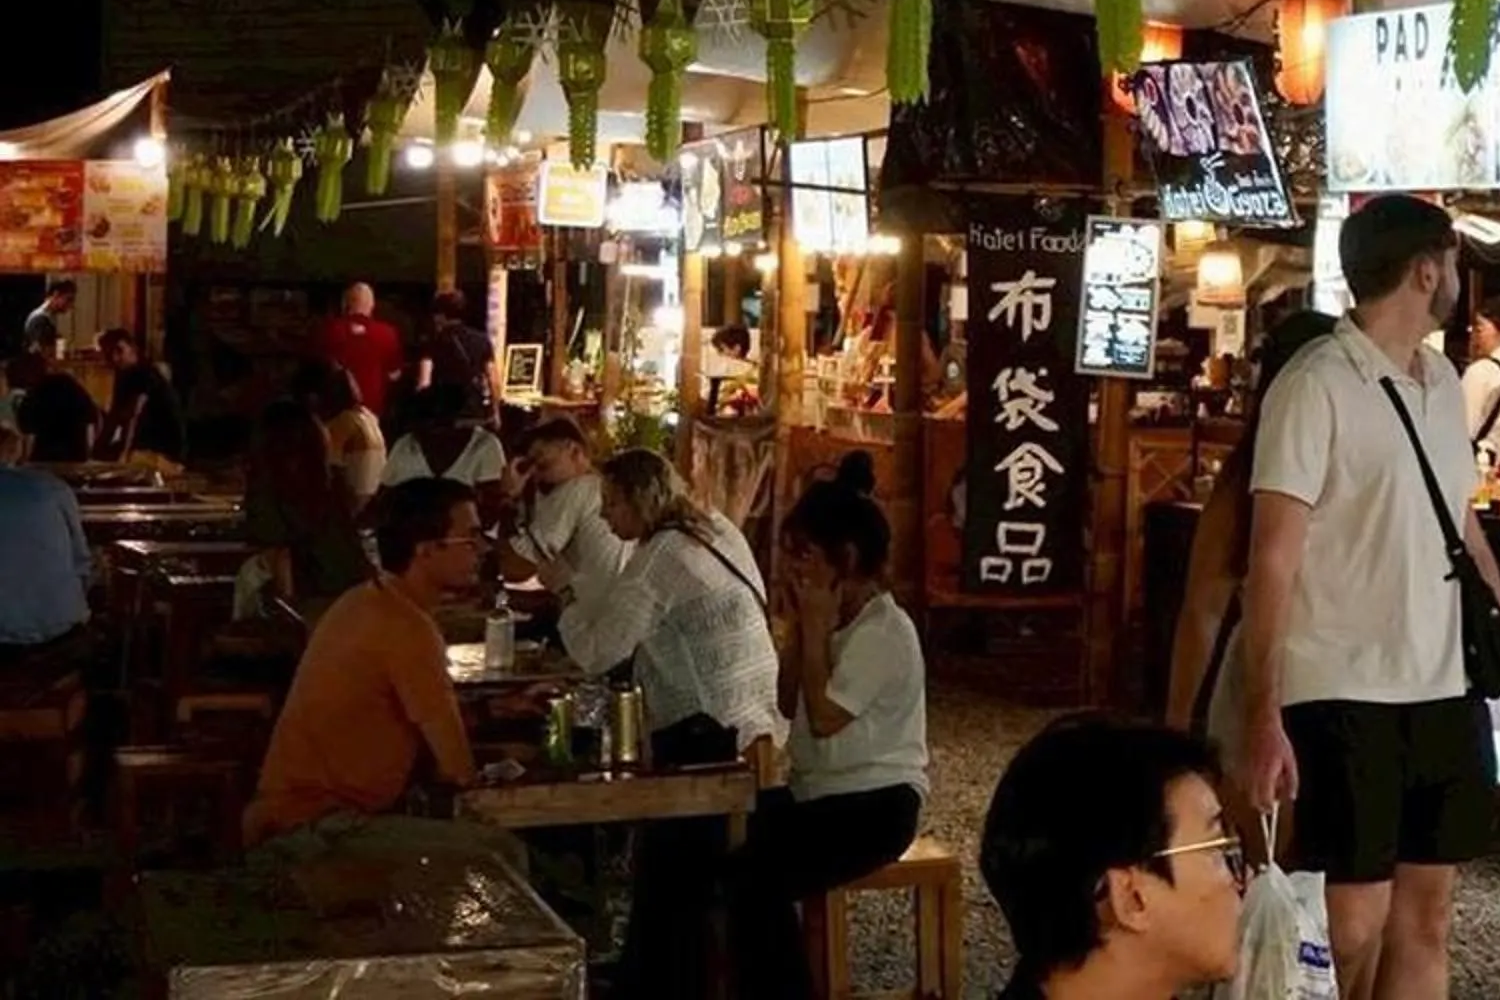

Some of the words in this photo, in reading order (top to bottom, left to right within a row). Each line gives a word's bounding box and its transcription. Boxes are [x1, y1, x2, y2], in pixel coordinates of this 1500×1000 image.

[1375, 11, 1430, 65] PAD
[980, 269, 1065, 585] 布袋食品
